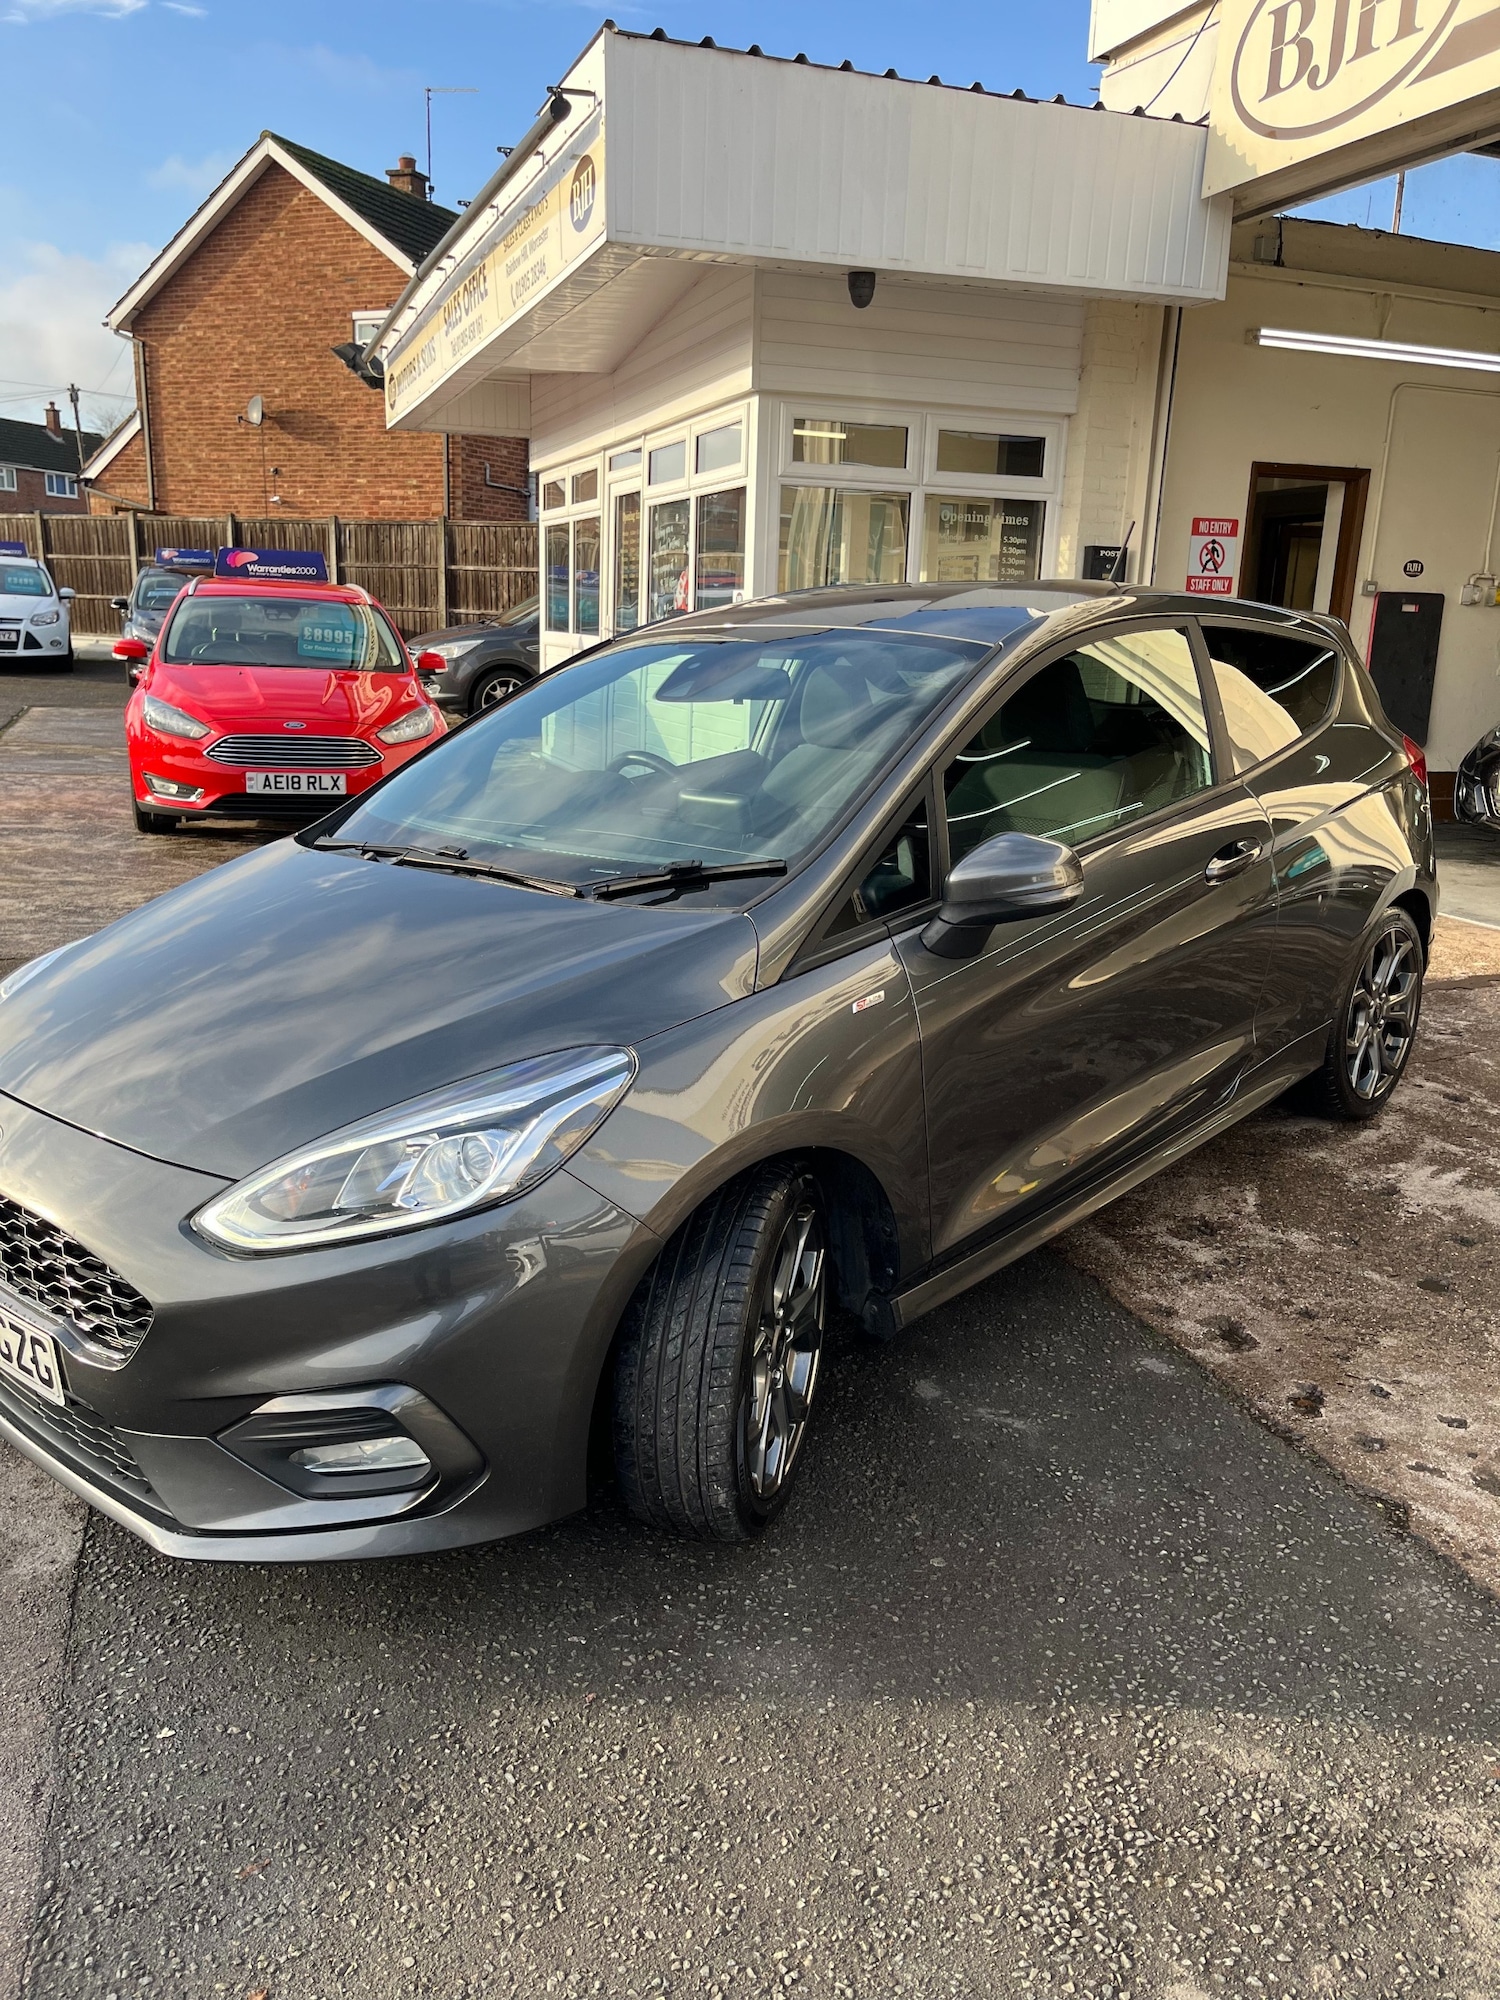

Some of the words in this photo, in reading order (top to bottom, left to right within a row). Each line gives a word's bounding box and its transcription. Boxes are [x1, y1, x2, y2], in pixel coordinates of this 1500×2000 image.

[1258, 0, 1424, 103] BJH
[573, 164, 593, 223] BJH
[443, 290, 462, 337] SALES
[463, 262, 488, 317] OFFICE
[941, 509, 991, 527] Opening
[995, 512, 1029, 526] times
[1199, 521, 1209, 533] NO
[1210, 521, 1232, 534] ENTRY
[1003, 536, 1028, 544] 5.30pm
[1002, 546, 1026, 555] 5.30pm
[1001, 557, 1026, 565] 5.30pm
[246, 563, 317, 576] Warranties2000
[1000, 567, 1025, 576] 5.30pm
[1190, 578, 1211, 591] STAFF
[1212, 579, 1229, 591] ONLY
[303, 626, 354, 644] £8995
[263, 774, 301, 790] AE18
[307, 775, 340, 790] RLX
[857, 998, 867, 1010] ST
